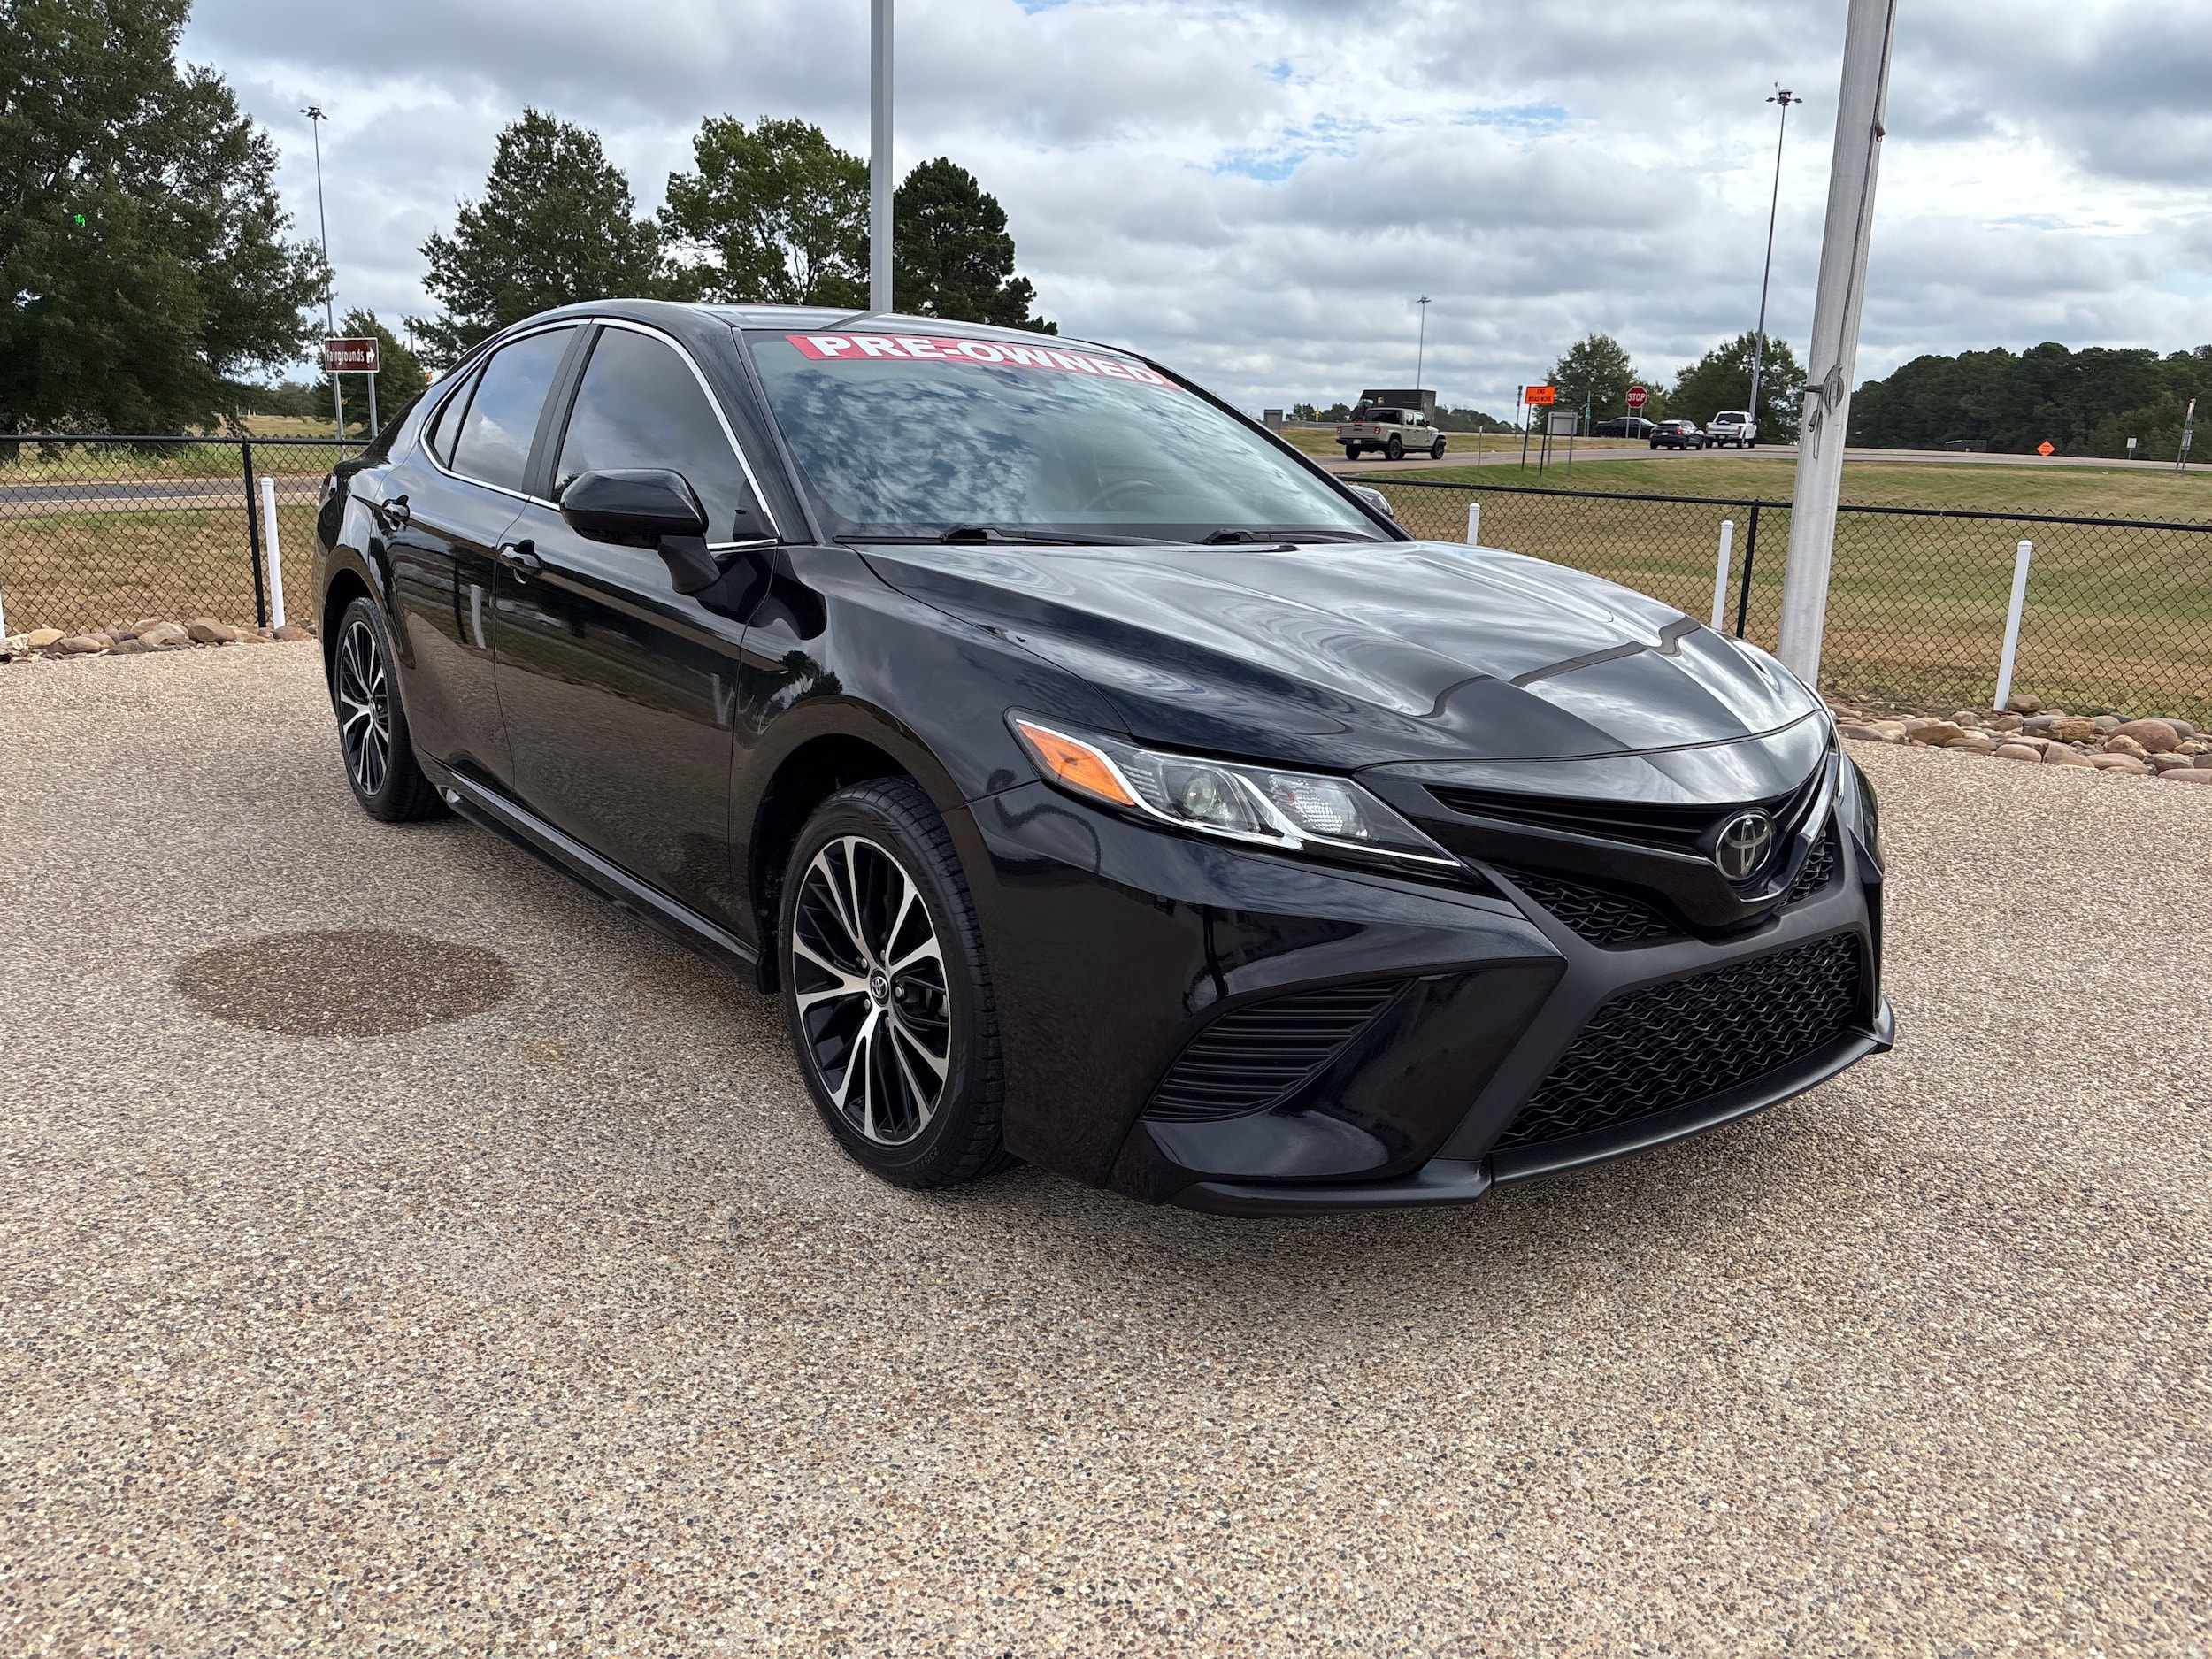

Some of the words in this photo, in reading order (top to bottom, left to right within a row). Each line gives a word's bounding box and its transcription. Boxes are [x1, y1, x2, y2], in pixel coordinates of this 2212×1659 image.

[326, 348, 365, 365] Fairgrounds
[806, 336, 1164, 386] PRE-OWNED
[1627, 392, 1646, 402] STOP
